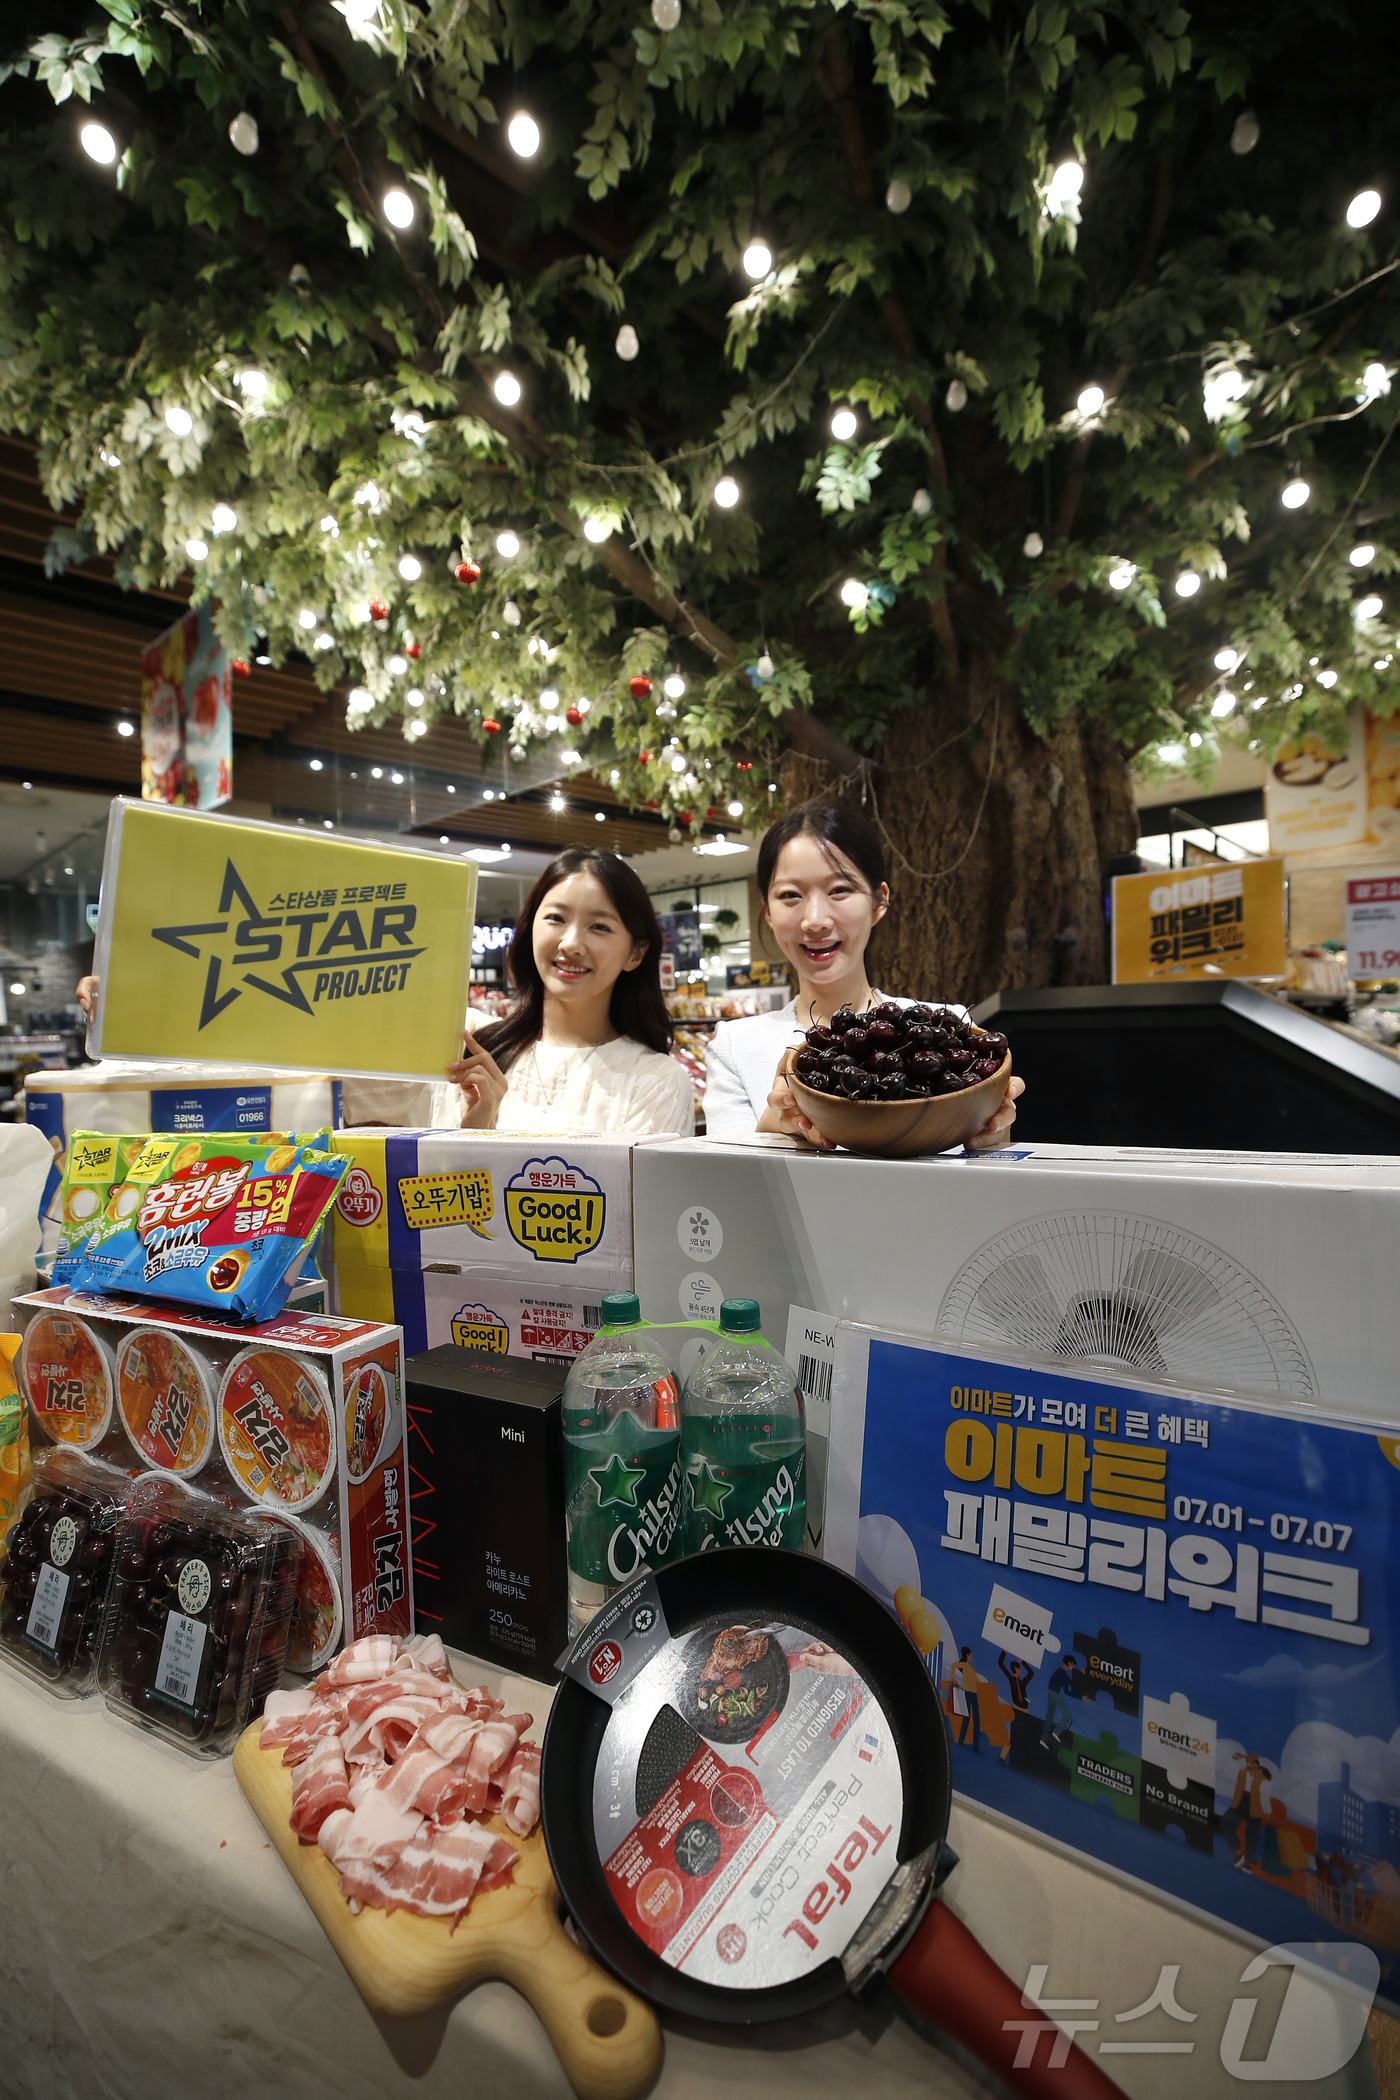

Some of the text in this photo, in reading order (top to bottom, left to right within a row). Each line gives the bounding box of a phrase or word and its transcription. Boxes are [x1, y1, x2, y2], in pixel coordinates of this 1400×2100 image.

[268, 883, 407, 911] 스타상품 프로젝트
[1150, 868, 1243, 913] 이마트
[1151, 896, 1243, 938] 패밀리
[232, 904, 416, 964] STAR
[1151, 931, 1244, 964] 위크
[313, 963, 411, 1002] PROJECT
[239, 1112, 264, 1122] 01966
[85, 1147, 111, 1161] STAR
[147, 1151, 170, 1162] STAR
[529, 1172, 577, 1188] 행운가득
[138, 1163, 251, 1229] 홈런볼
[344, 1196, 374, 1213] 오뚜기
[411, 1181, 484, 1213] 오뚜기밥
[519, 1196, 582, 1221] Good
[234, 1209, 268, 1233] 중량
[251, 1239, 264, 1251] 초코
[466, 1312, 493, 1323] 행운가득
[460, 1326, 495, 1341] Good
[46, 1378, 86, 1412] 김치
[250, 1380, 284, 1421] 사발면
[159, 1384, 191, 1457] 김치
[950, 1386, 1209, 1448] 이마트가 모여 더 큰 혜택
[234, 1398, 290, 1468] 김치
[501, 1426, 526, 1443] Mini
[945, 1418, 1167, 1520] 이마트
[384, 1465, 398, 1529] 사발면
[1174, 1496, 1243, 1532] 07.01
[1270, 1513, 1352, 1551] 07.07
[373, 1531, 404, 1613] 김치
[485, 1551, 501, 1565] 카누
[941, 1489, 1370, 1646] 패밀리위크
[486, 1565, 531, 1587] 라이트 로스트
[486, 1579, 527, 1600] 아메리카노
[489, 1608, 513, 1627] 250
[993, 1607, 1044, 1646] emart
[1089, 1669, 1134, 1692] everyday
[1090, 1655, 1134, 1682] emart
[778, 1687, 846, 1780] DESIGNED TO LAST
[1148, 1721, 1210, 1755] emart24
[700, 1763, 716, 1784] SEARING
[705, 1769, 721, 1790] PERFECT
[1080, 1757, 1132, 1785] TRADERS
[1081, 1768, 1114, 1788] WHOLESALE
[679, 1800, 696, 1822] DURABLE
[815, 1789, 828, 1806] ALL
[1146, 1783, 1164, 1799] No
[1168, 1793, 1208, 1818] Brand
[664, 1808, 682, 1830] COATING
[748, 1818, 775, 1857] PERFECT
[751, 1774, 863, 1930] Perfect Cook
[642, 1857, 652, 1869] FAST
[644, 1878, 669, 1911] INDUCTION
[713, 1861, 745, 1905] COOKING
[782, 1815, 893, 1950] Tefal
[651, 1887, 675, 1917] SUPERIOR
[670, 1903, 714, 1963] GUARANTEE
